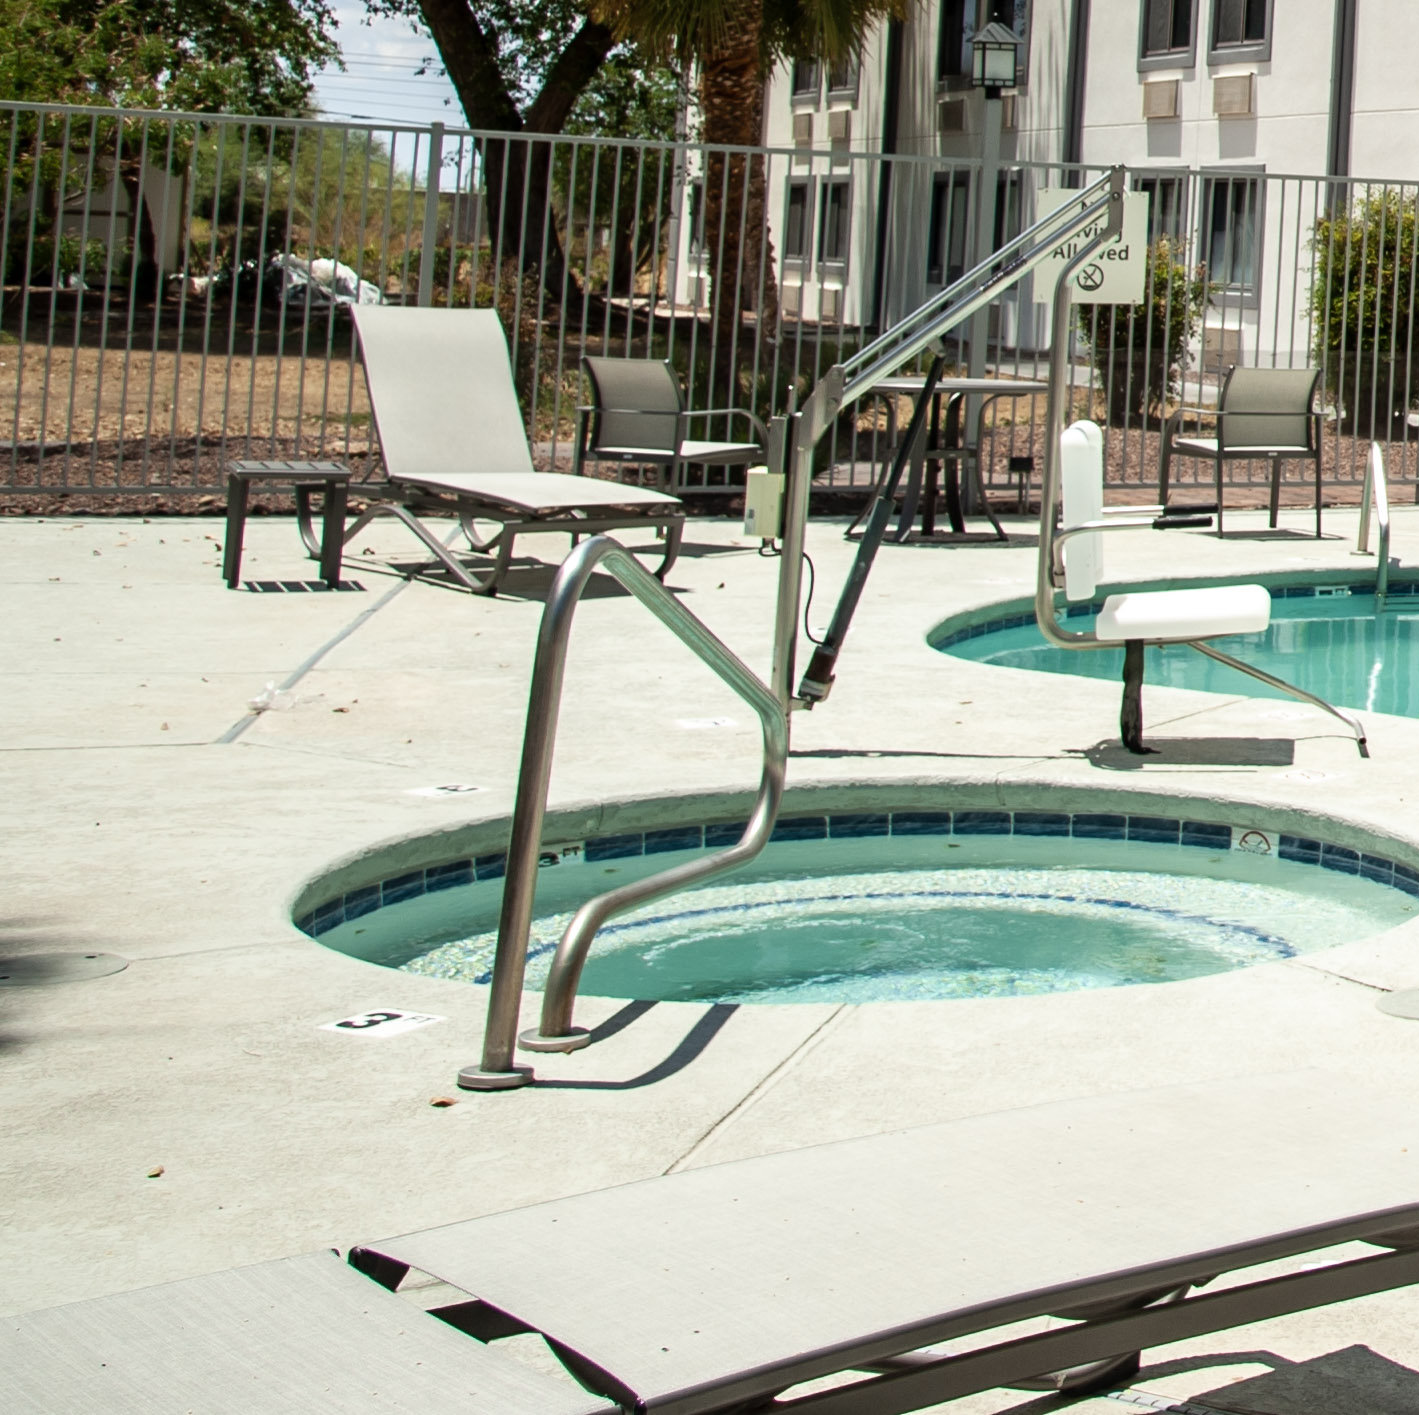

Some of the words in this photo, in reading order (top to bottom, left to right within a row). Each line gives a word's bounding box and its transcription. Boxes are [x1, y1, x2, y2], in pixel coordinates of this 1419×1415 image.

[1052, 243, 1129, 261] Alled
[538, 852, 560, 868] 3
[562, 846, 580, 857] FT
[335, 1012, 404, 1029] 3
